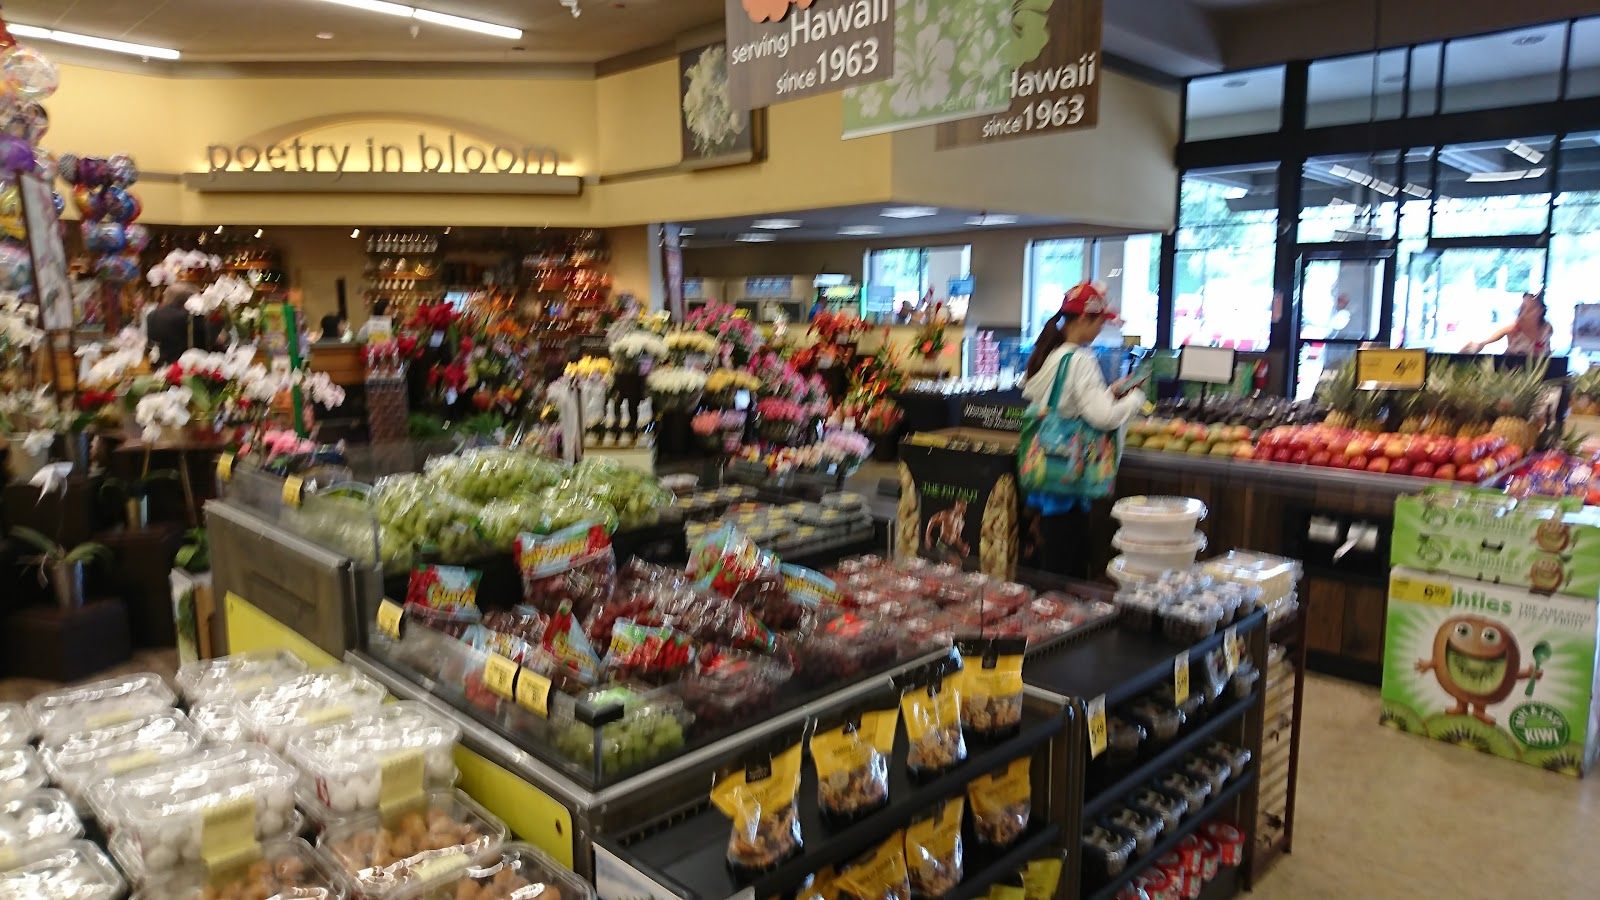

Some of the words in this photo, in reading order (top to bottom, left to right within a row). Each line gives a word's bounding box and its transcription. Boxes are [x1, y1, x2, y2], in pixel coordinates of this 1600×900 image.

[731, 33, 789, 66] serving
[789, 0, 888, 47] Hawaii
[775, 67, 816, 96] since
[815, 36, 881, 85] 1963
[981, 113, 1023, 138] since
[1022, 93, 1086, 131] 1963
[206, 136, 351, 183] poetry
[366, 137, 404, 173] in
[418, 133, 560, 176] bloom
[1523, 727, 1561, 747] KIWI
